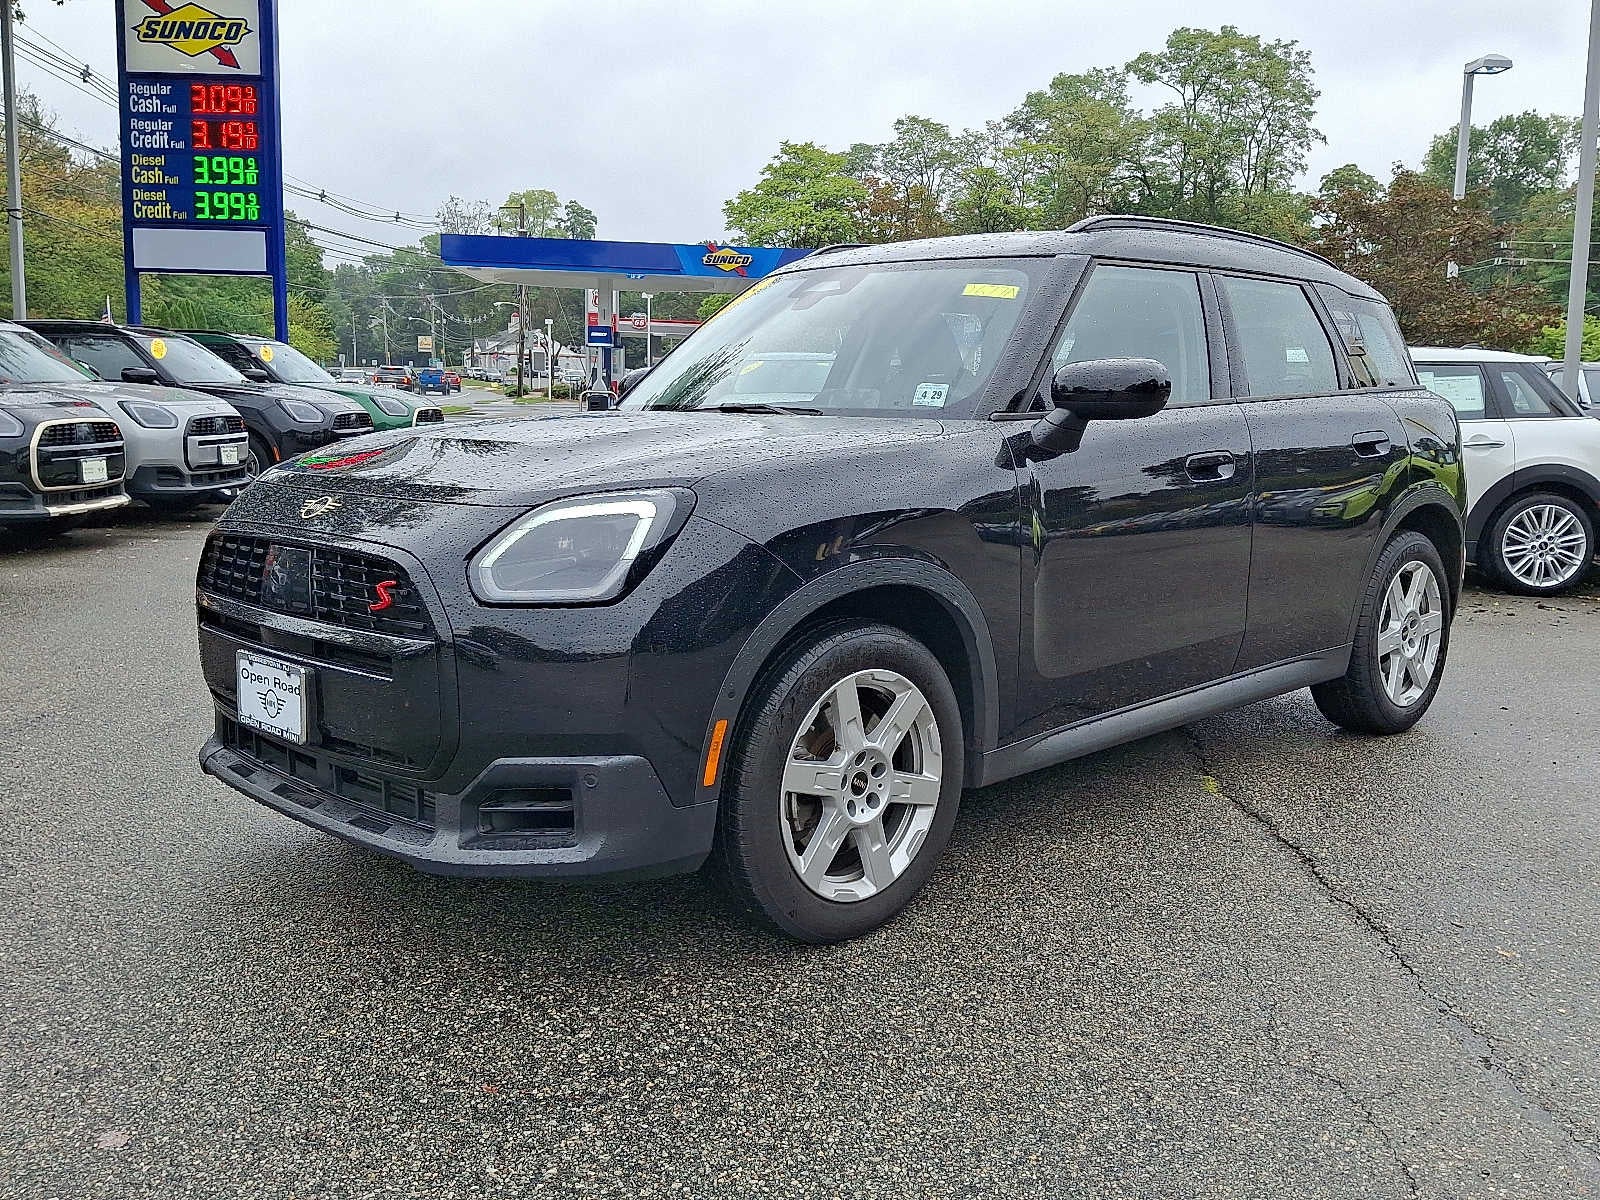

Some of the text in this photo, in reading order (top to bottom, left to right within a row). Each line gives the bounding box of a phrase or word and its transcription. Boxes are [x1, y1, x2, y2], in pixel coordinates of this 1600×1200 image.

[142, 20, 243, 41] SUNOCO
[129, 82, 172, 97] Regular
[129, 94, 177, 113] Cash Full
[130, 118, 174, 133] Regular
[130, 130, 185, 149] Credit Full
[131, 153, 165, 166] Diesel
[131, 166, 179, 185] Cash Full
[132, 189, 167, 201] Diesel
[133, 200, 187, 220] Credit Full
[704, 254, 751, 265] SUNOCO
[921, 390, 943, 400] 4 29
[369, 580, 397, 611] S
[241, 667, 301, 697] Open Road
[240, 715, 300, 743] OPEN ROAD MINI
